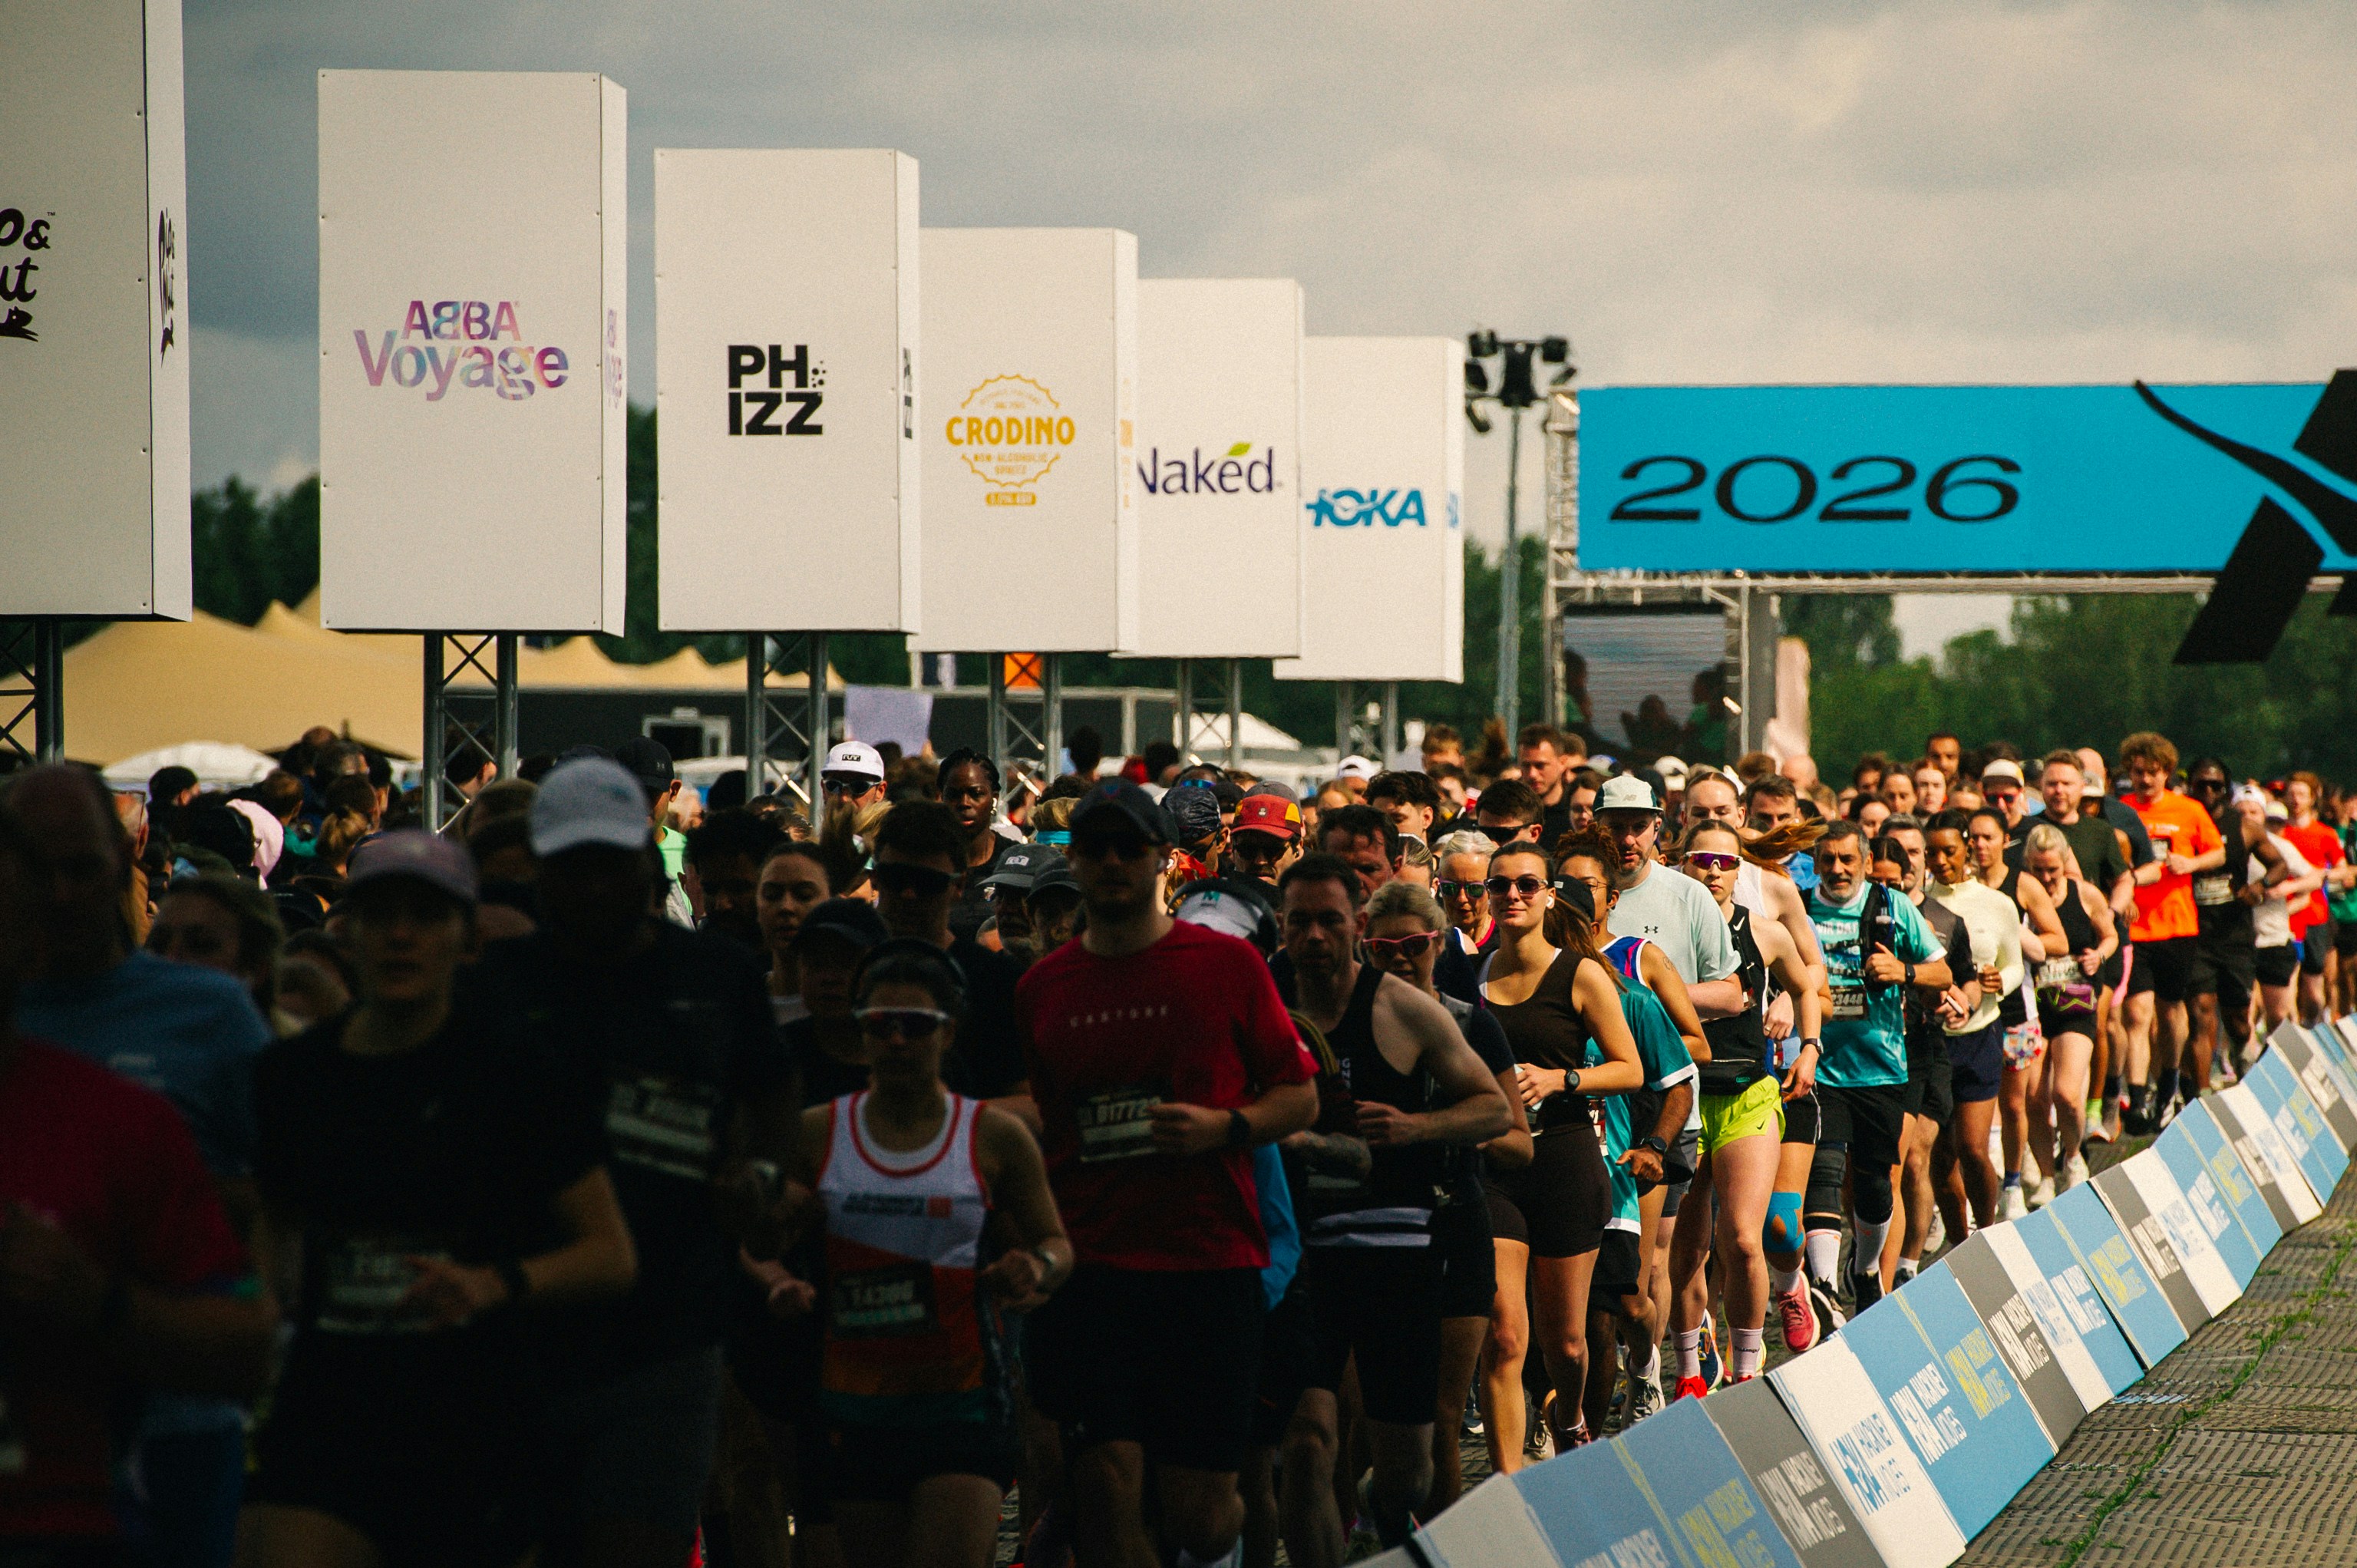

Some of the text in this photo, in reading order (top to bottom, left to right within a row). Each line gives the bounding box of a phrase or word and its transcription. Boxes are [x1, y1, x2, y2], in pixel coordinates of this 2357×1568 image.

[401, 301, 521, 340] ABBA
[353, 329, 569, 401] Voyage
[728, 391, 824, 435] IZZ
[946, 416, 1075, 445] CRODINO
[1609, 456, 2022, 522] 2026
